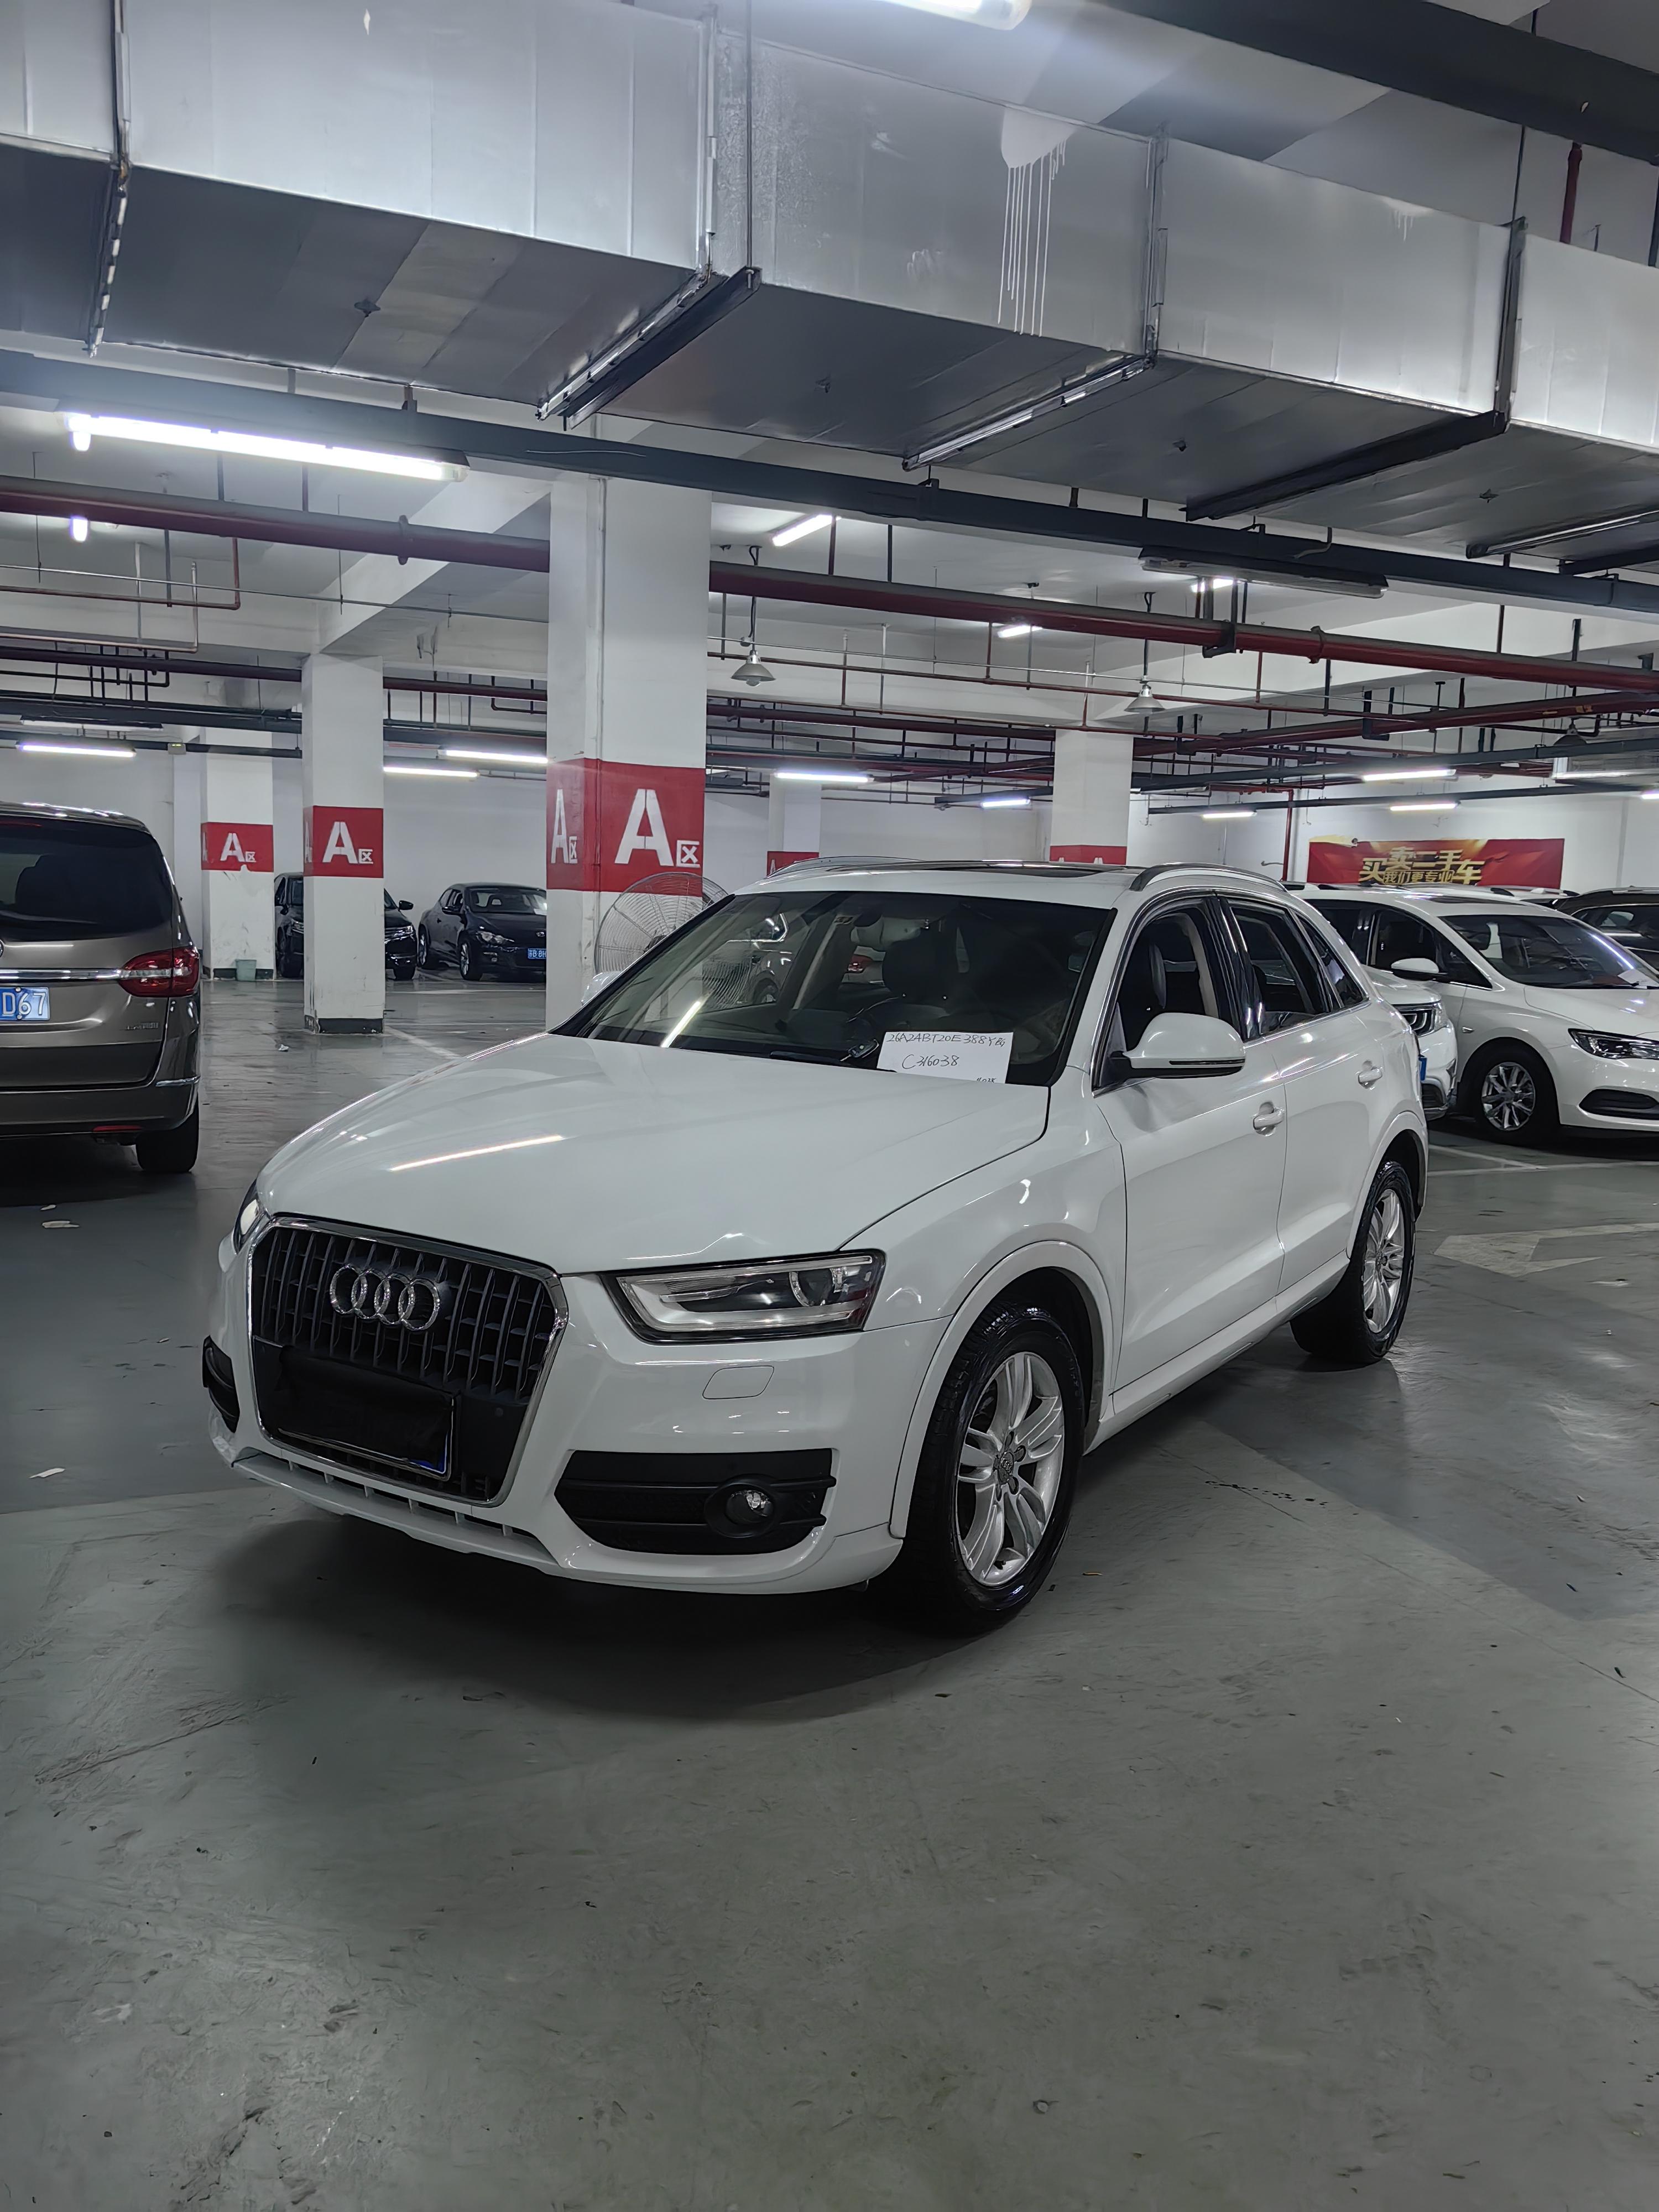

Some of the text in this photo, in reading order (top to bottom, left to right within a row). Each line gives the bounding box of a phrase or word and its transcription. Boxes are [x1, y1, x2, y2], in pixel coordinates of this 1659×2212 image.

[322, 821, 373, 864] A区
[551, 789, 578, 864] A区
[614, 789, 701, 868] A区
[220, 832, 256, 863] A区
[1359, 846, 1485, 885] 买卖二手车
[2, 992, 46, 1015] D67
